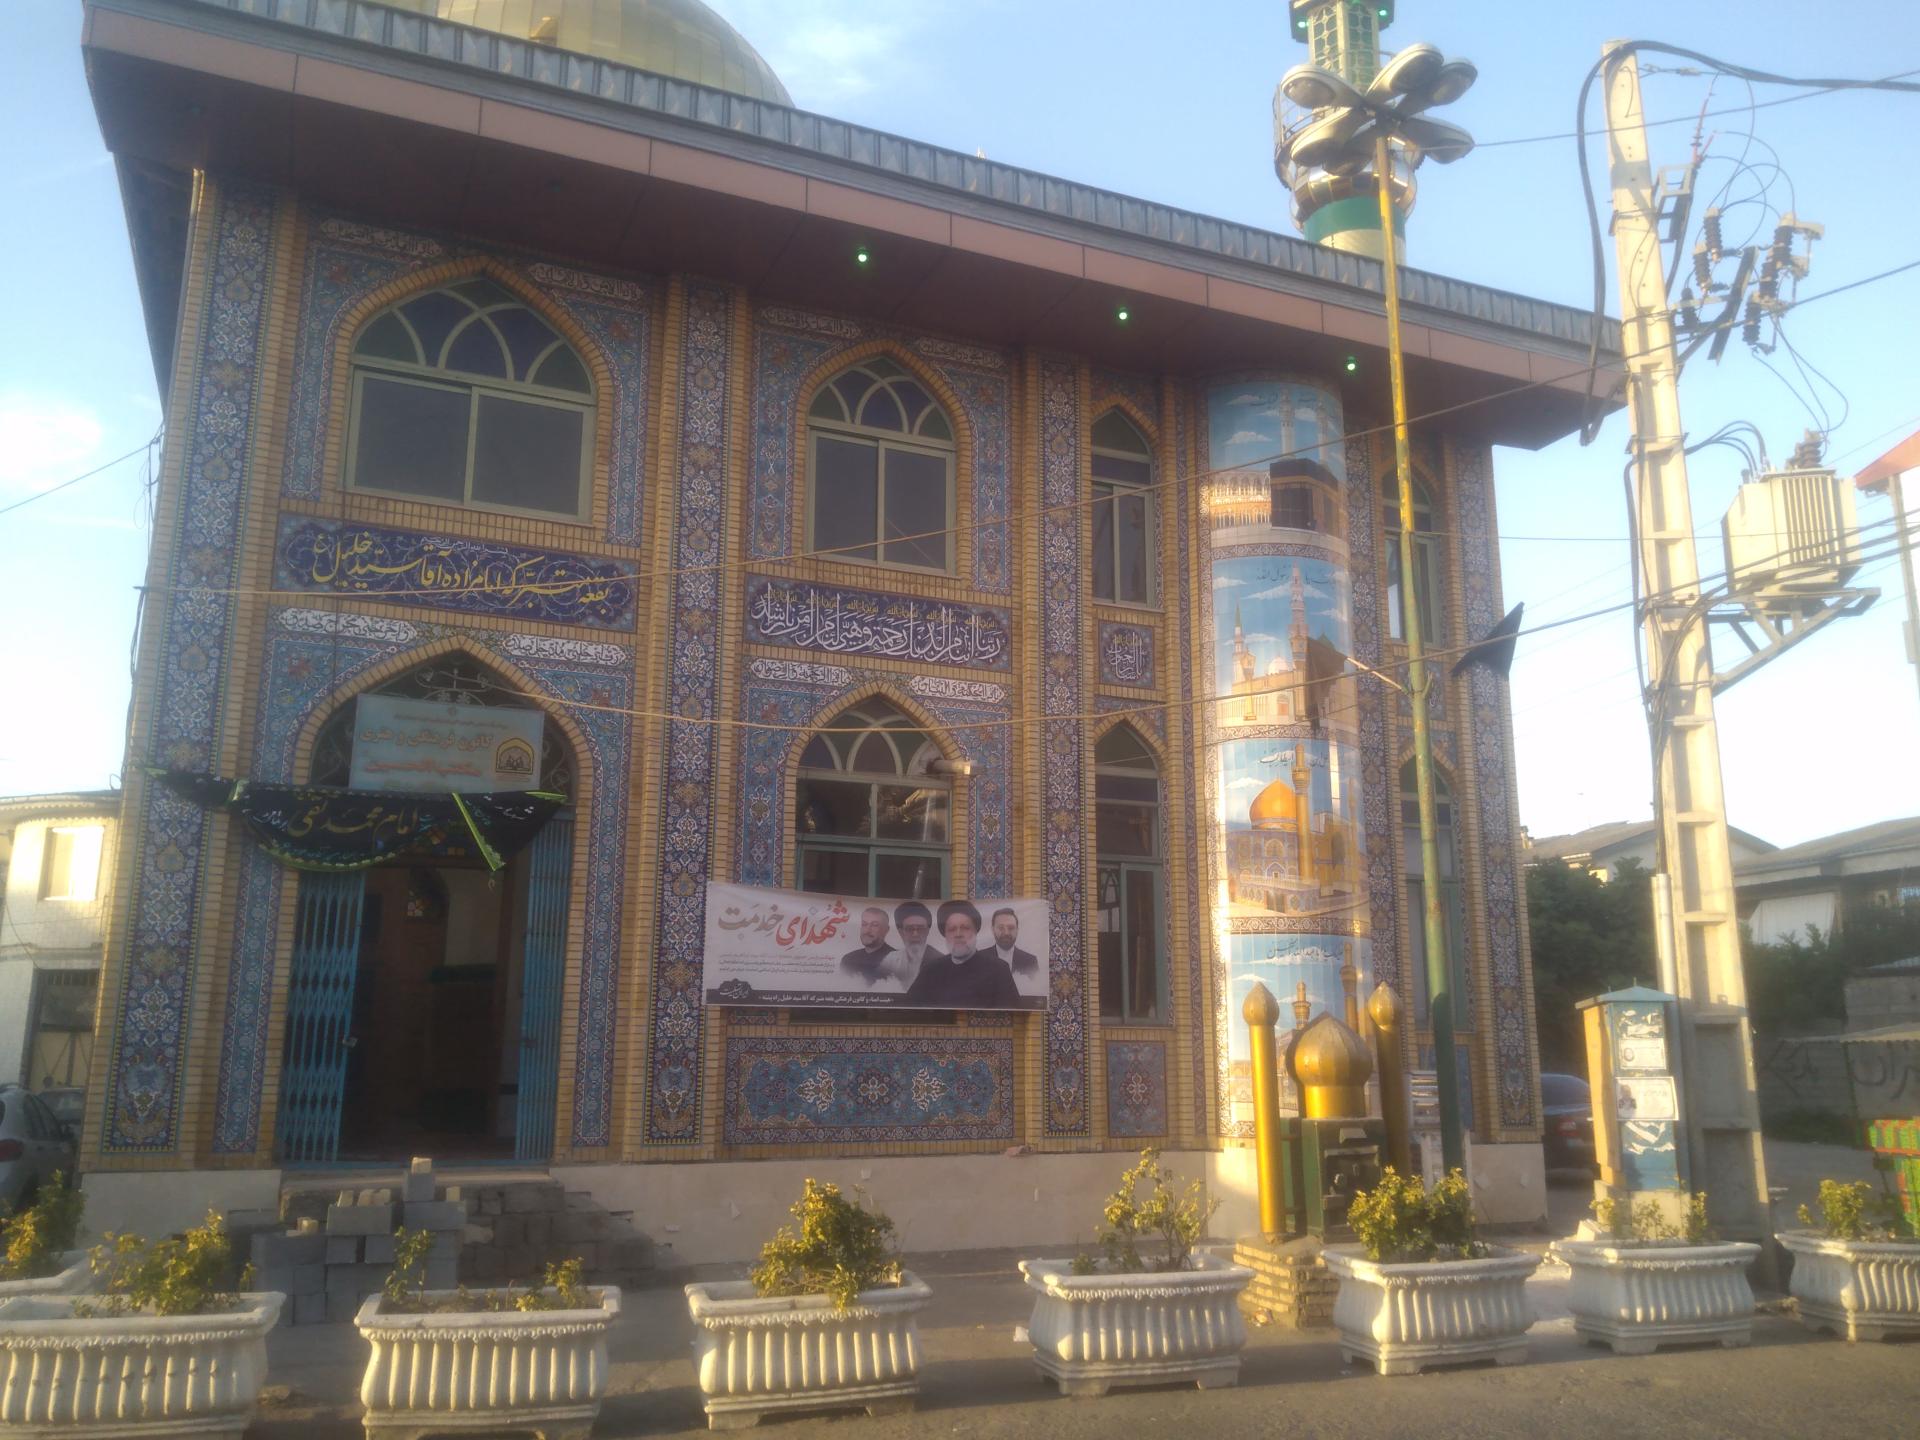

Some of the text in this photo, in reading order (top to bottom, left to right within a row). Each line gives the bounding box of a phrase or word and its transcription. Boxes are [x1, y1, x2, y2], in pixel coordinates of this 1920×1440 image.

[420, 544, 452, 588] آقا
[359, 726, 394, 743] هنری
[395, 730, 406, 746] و
[458, 734, 496, 752] کانون
[717, 899, 850, 951] شهدای خدمت
